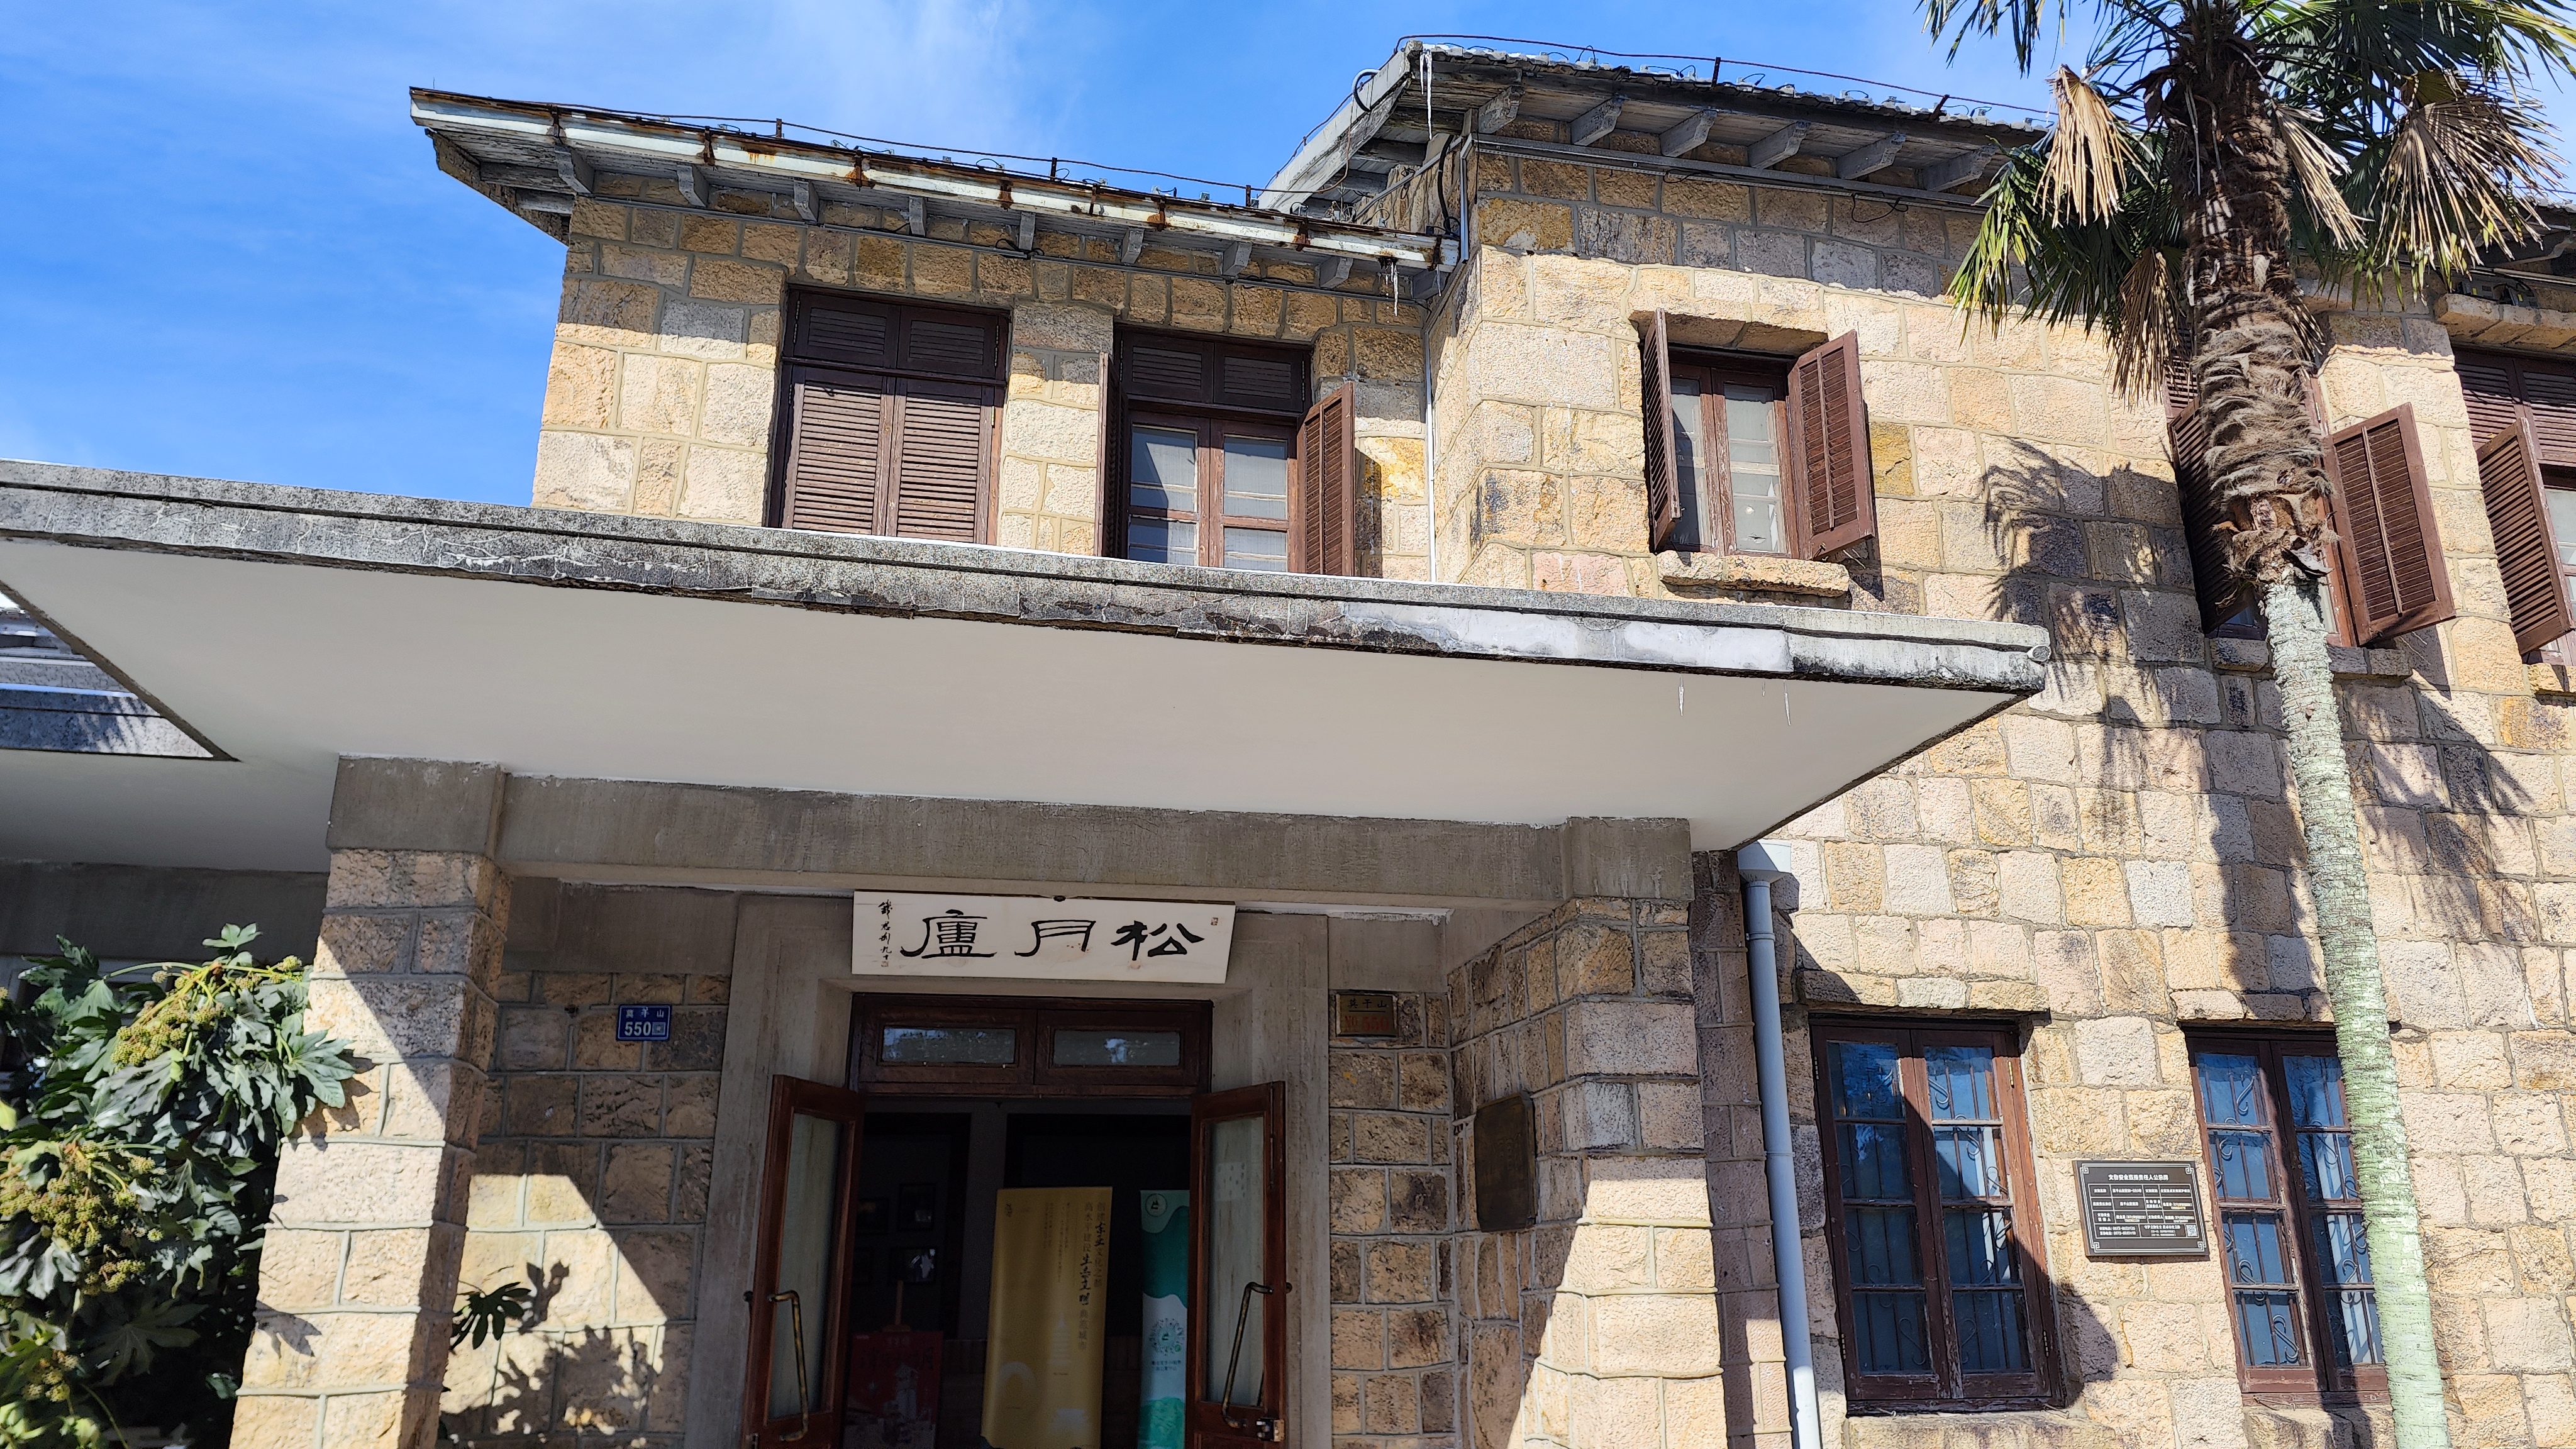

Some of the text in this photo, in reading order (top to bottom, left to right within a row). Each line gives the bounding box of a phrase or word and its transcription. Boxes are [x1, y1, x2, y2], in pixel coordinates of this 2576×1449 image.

[1348, 998, 1387, 1009] 莫干山
[625, 1008, 665, 1018] 莫干山
[625, 1021, 652, 1036] 550
